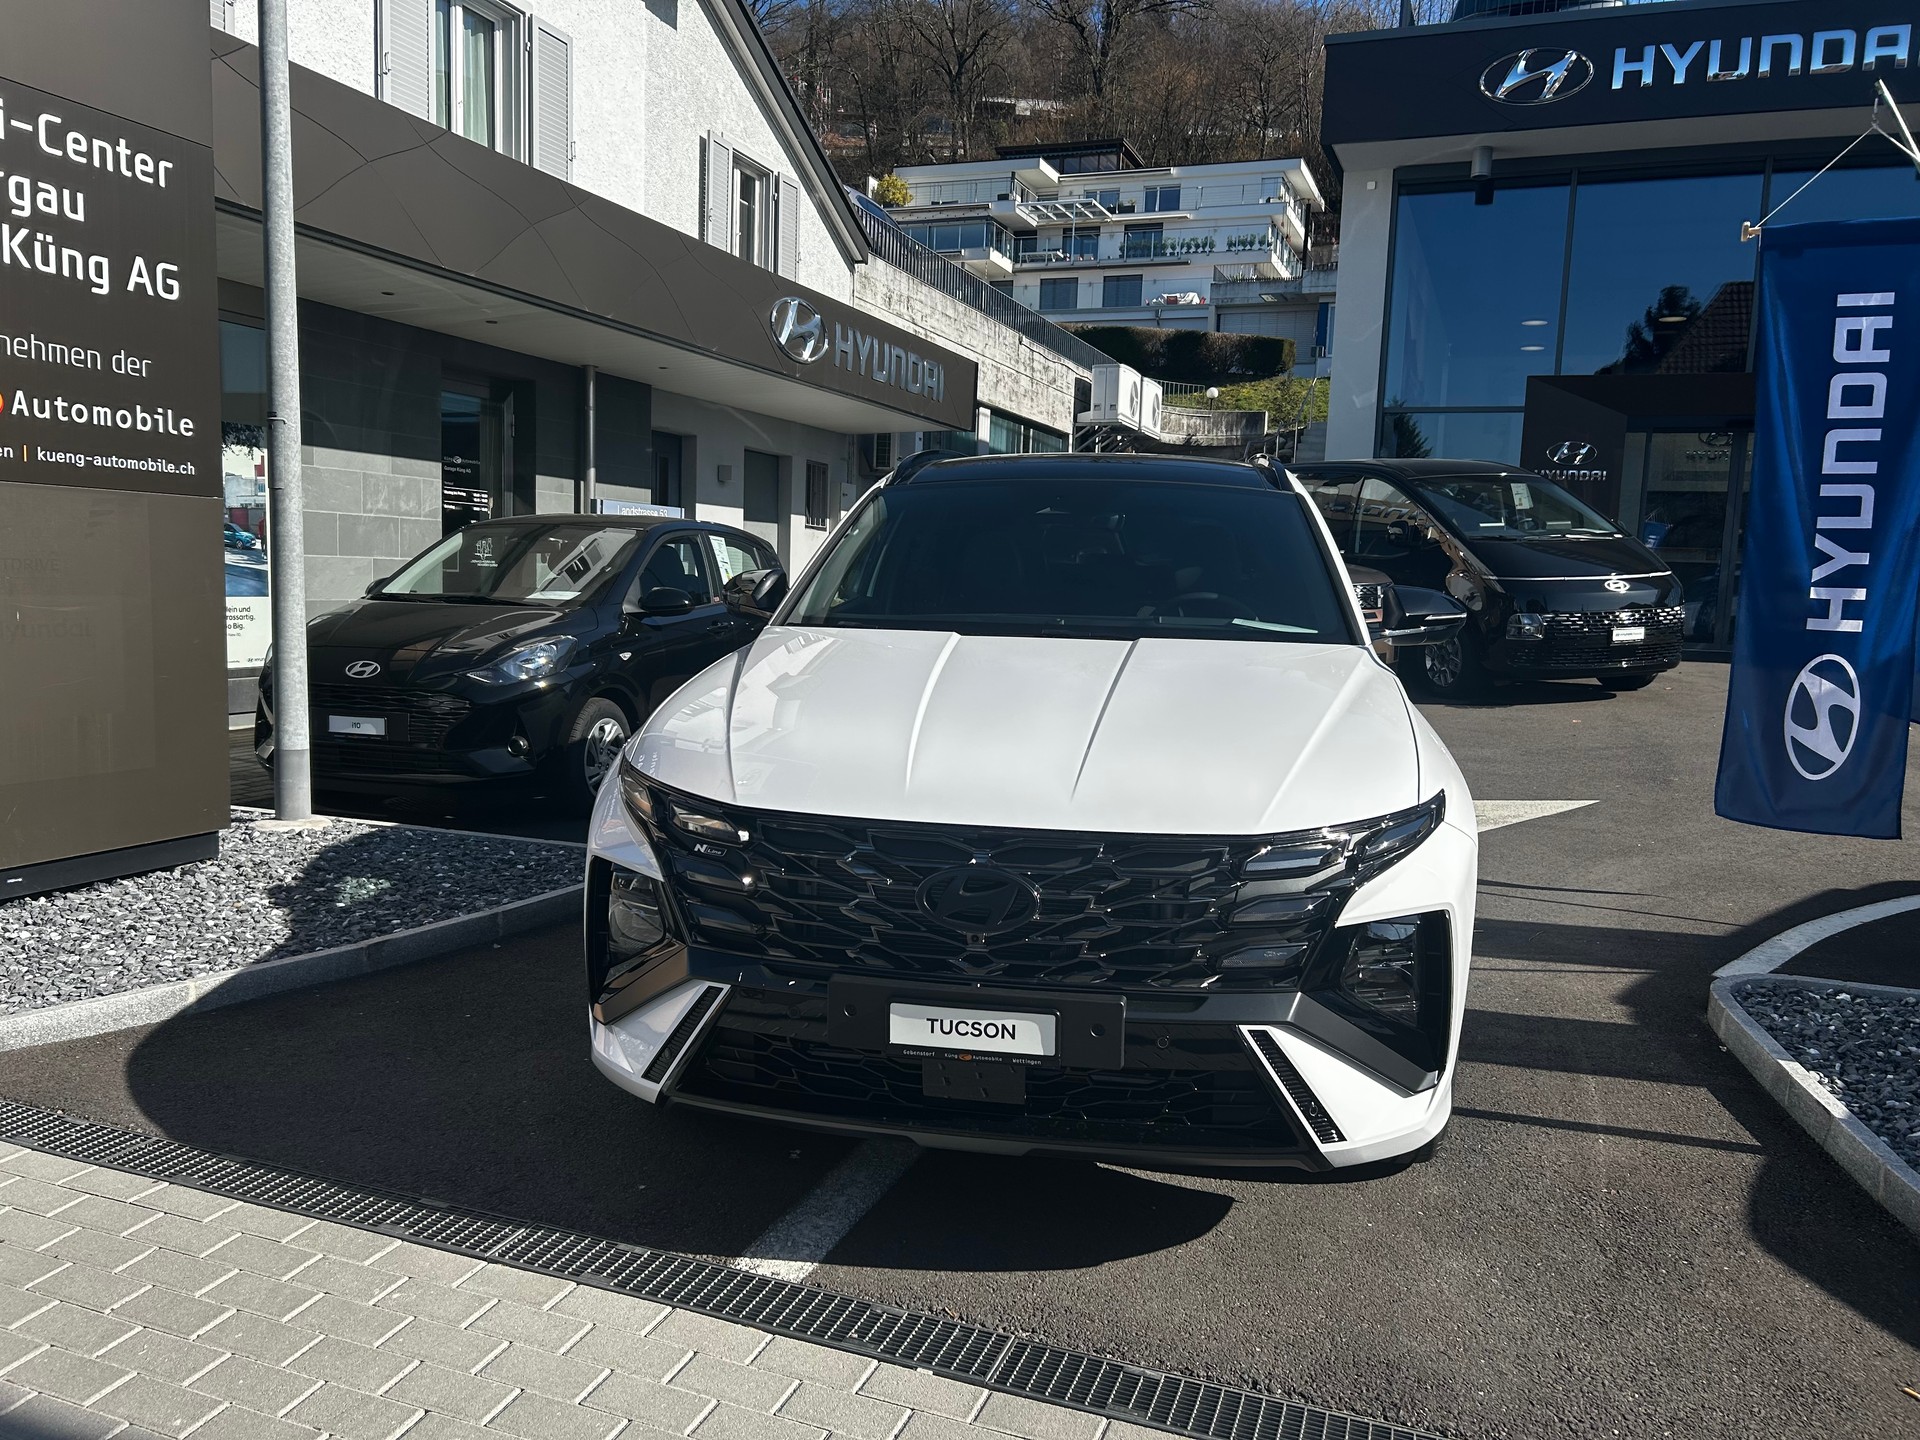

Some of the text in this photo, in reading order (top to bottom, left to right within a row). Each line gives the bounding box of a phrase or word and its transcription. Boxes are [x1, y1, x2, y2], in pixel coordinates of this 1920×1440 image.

[1611, 24, 1920, 89] HYUNDA
[2, 223, 181, 301] Küng AG
[112, 350, 152, 377] der
[833, 321, 945, 403] HYUNDAI
[11, 390, 194, 437] Automobile
[37, 446, 195, 476] kueng-automobile.ch
[1806, 292, 1896, 632] HYUNDAI
[694, 843, 707, 853] N
[926, 1018, 1016, 1041] TUCSON
